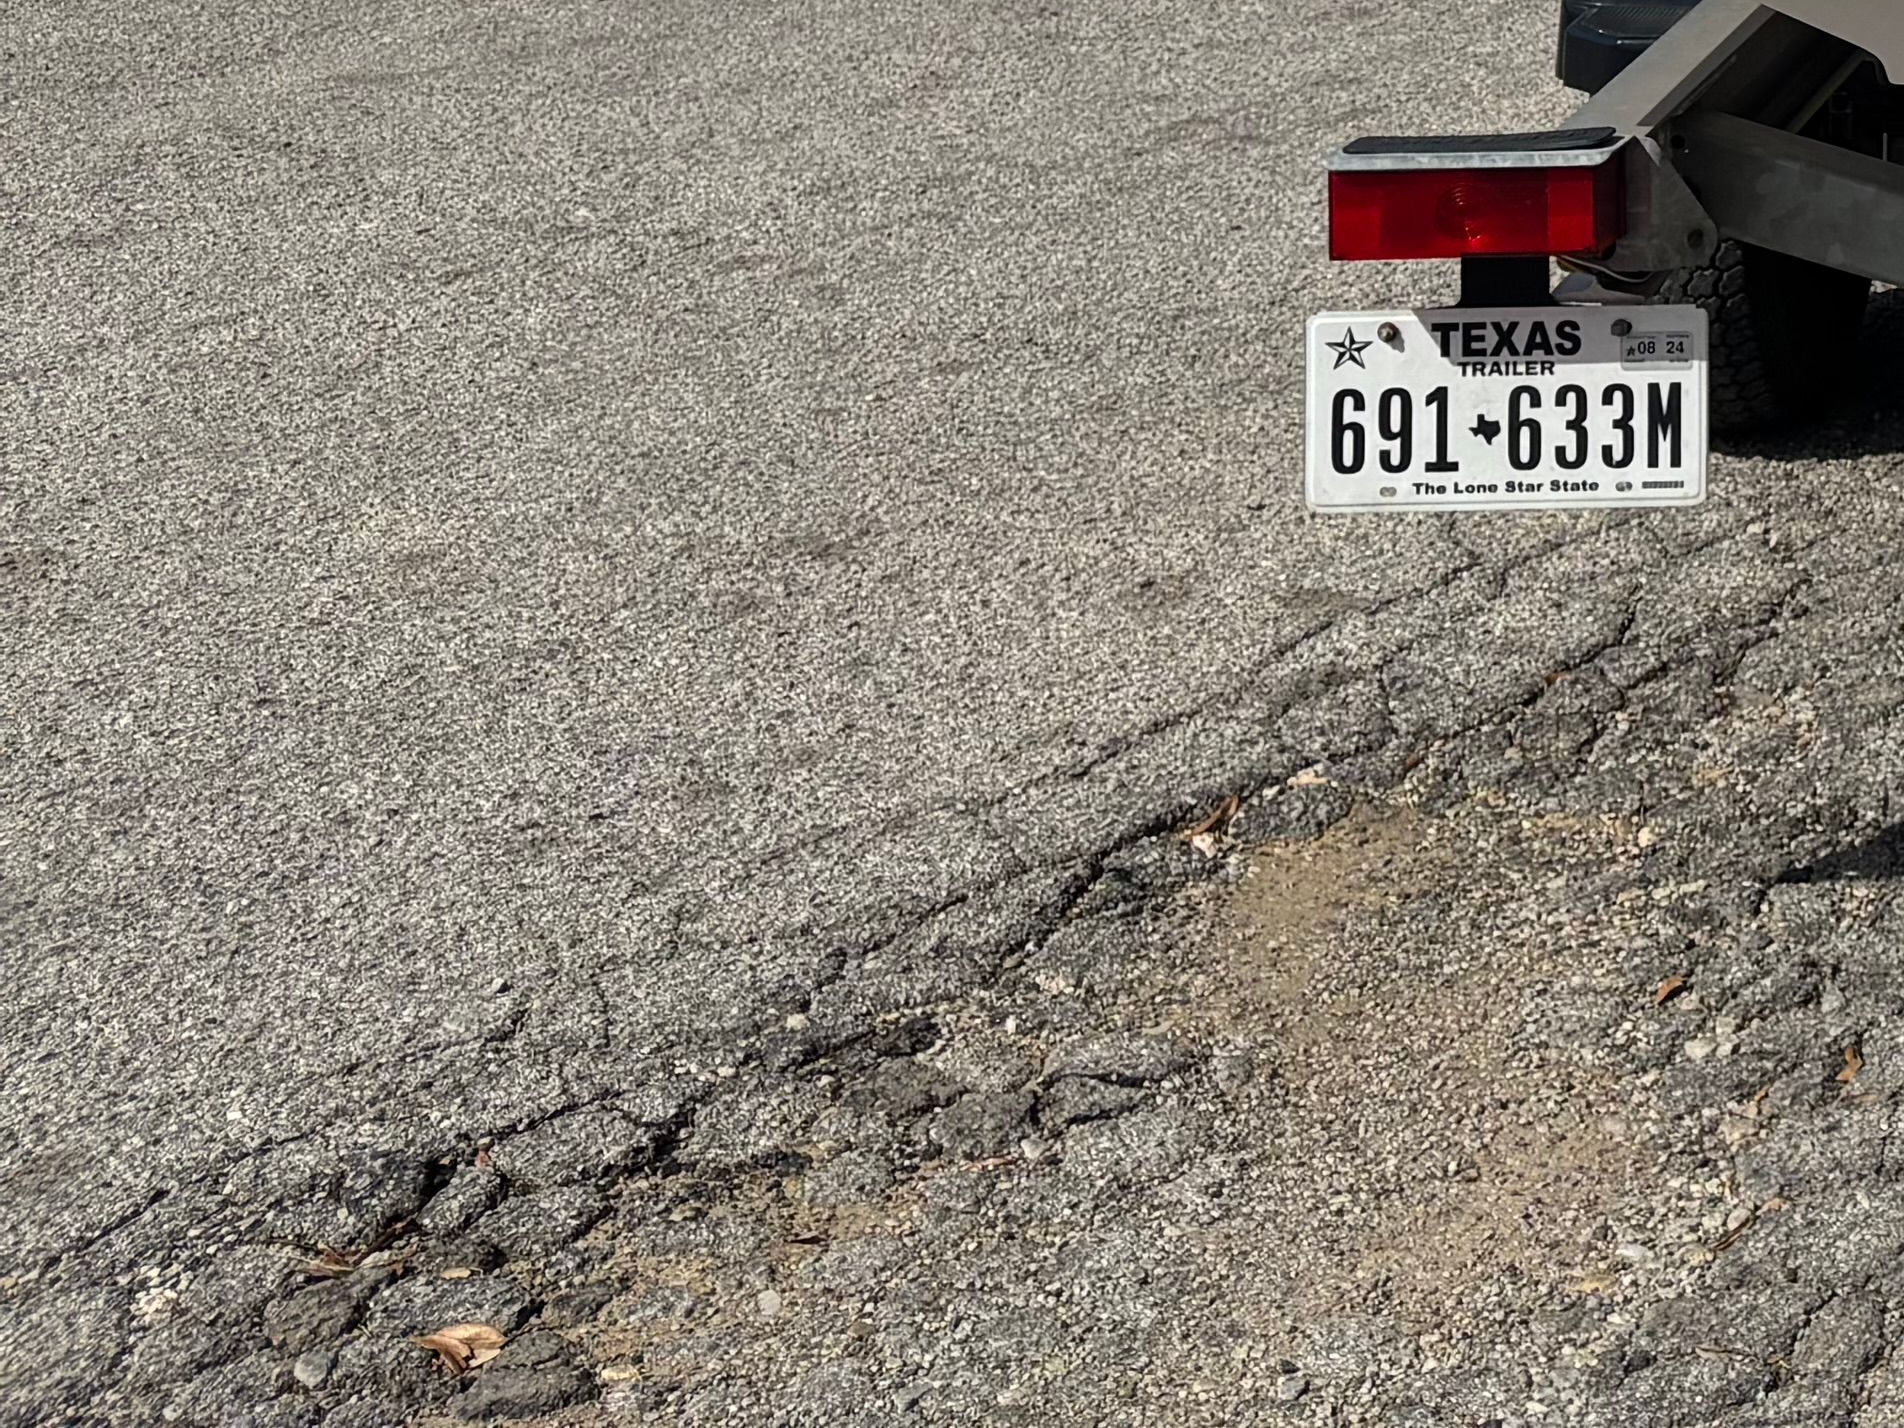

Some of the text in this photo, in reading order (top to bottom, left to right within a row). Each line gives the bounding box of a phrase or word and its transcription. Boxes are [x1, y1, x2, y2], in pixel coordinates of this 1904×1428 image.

[1431, 319, 1582, 357] TEXAS
[1636, 340, 1685, 354] 08 24
[1456, 360, 1556, 377] TRAILER
[1331, 381, 1682, 475] 691 633M
[1412, 479, 1600, 496] The Lone Star State
